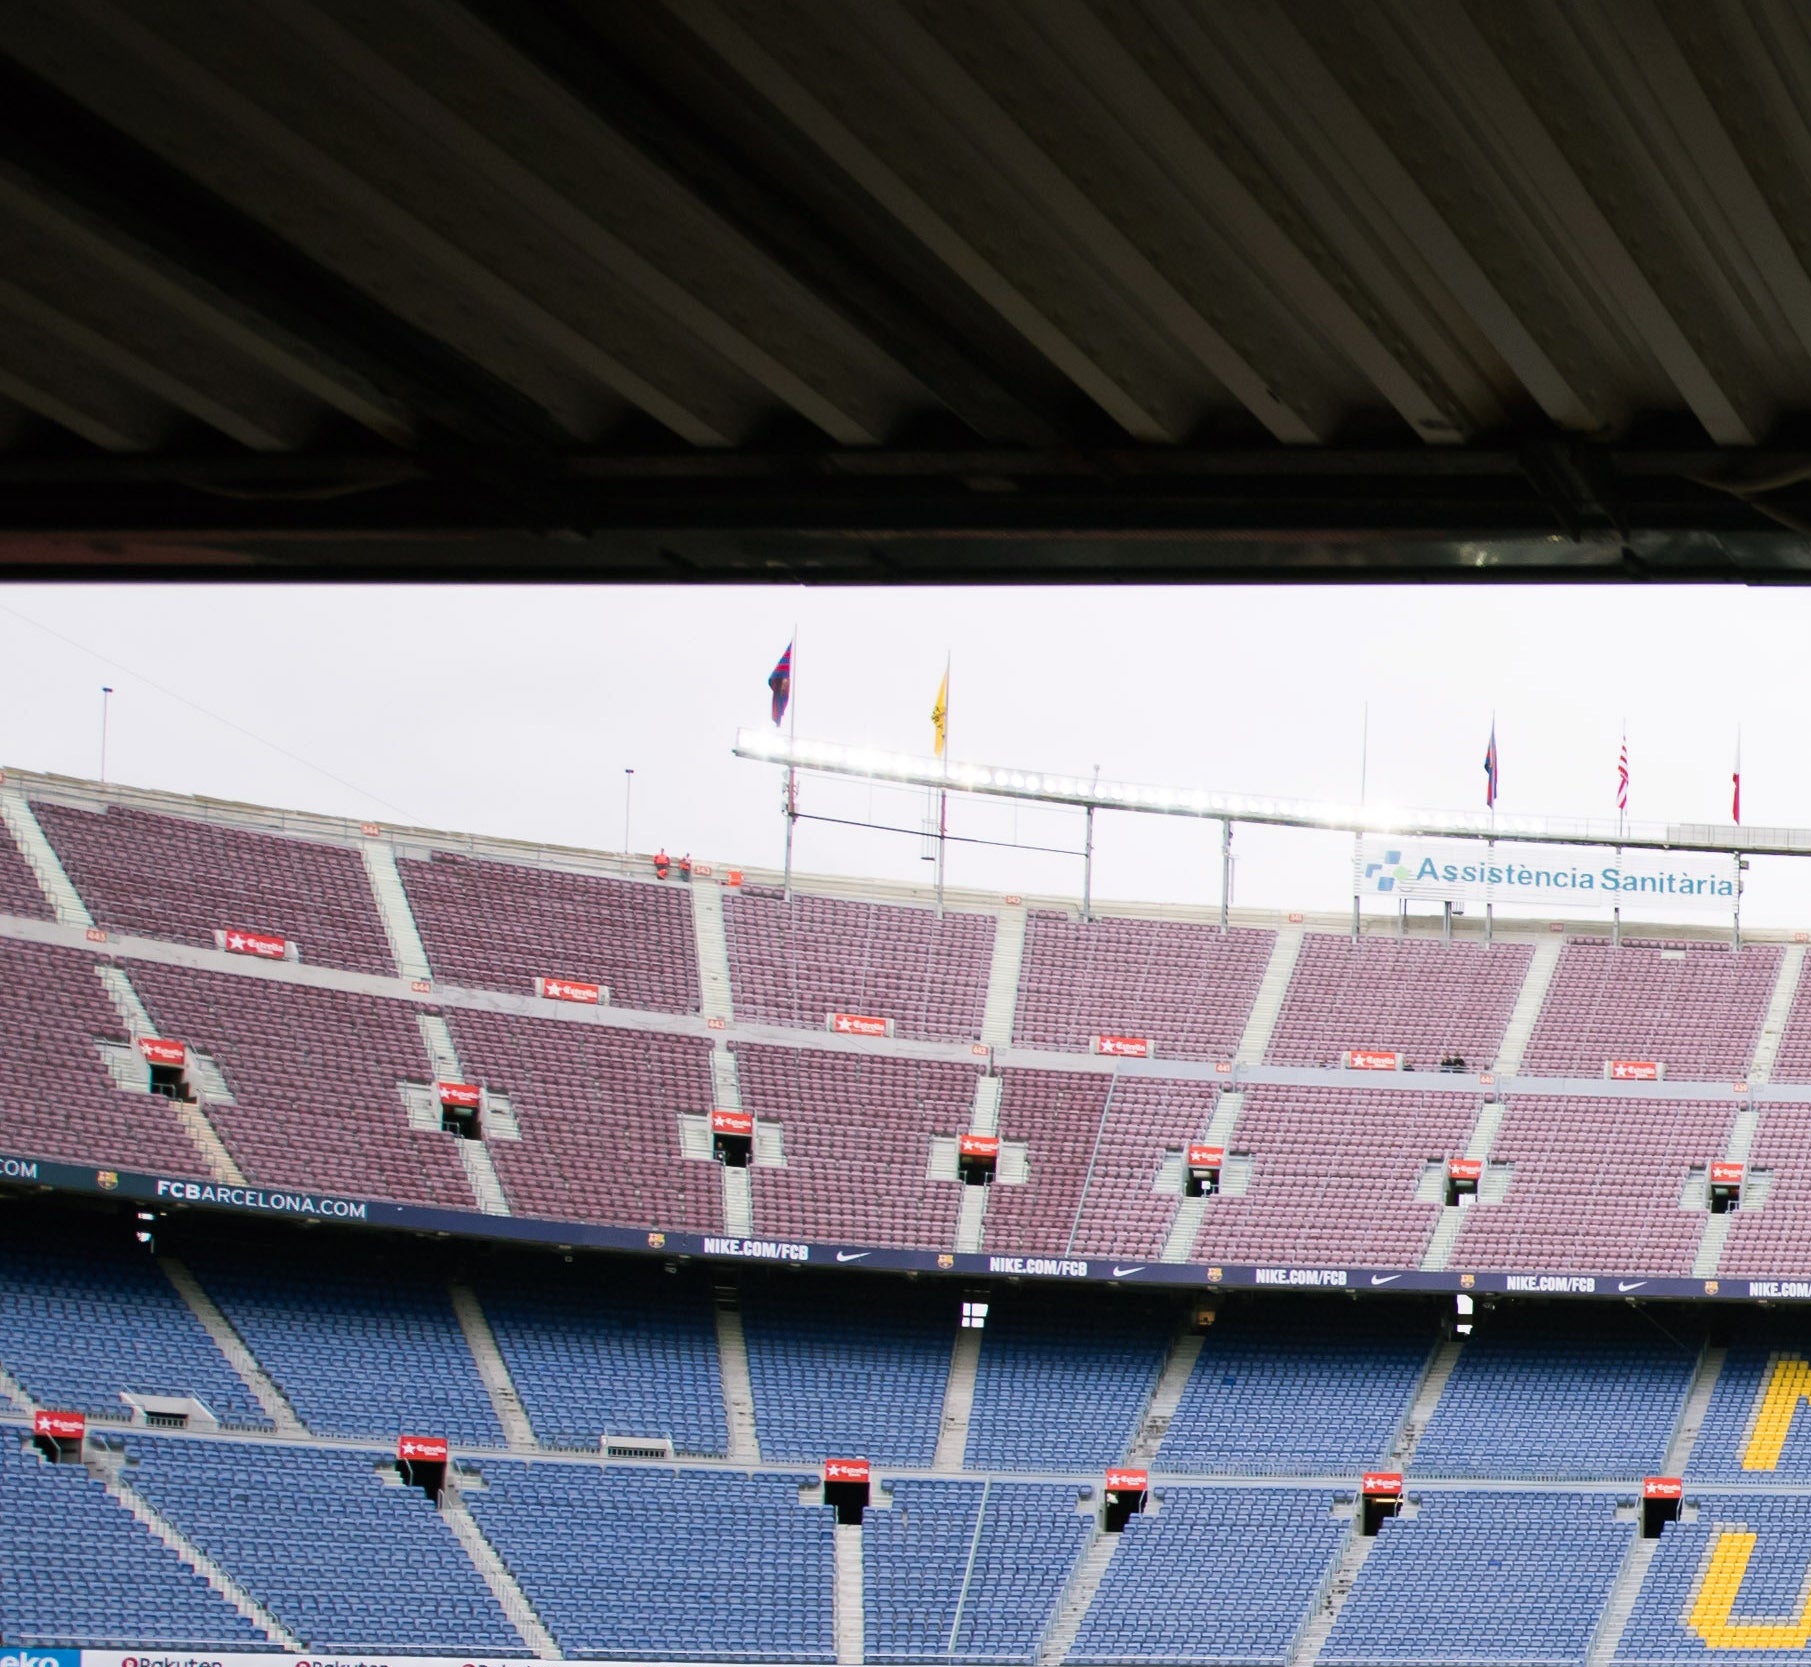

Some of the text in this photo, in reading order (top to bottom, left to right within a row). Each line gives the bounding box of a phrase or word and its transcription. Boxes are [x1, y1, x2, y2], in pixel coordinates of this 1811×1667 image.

[1416, 857, 1734, 896] Assistència Sanitària
[157, 1180, 366, 1218] FCBARCELONA.COM
[704, 1237, 808, 1260] NIKE.COM/FCB
[990, 1257, 1087, 1277] NIKE.COM/FCB
[1256, 1269, 1346, 1285] NIKE.COM/FCB
[1507, 1275, 1594, 1292] NIKE.COM/FCB
